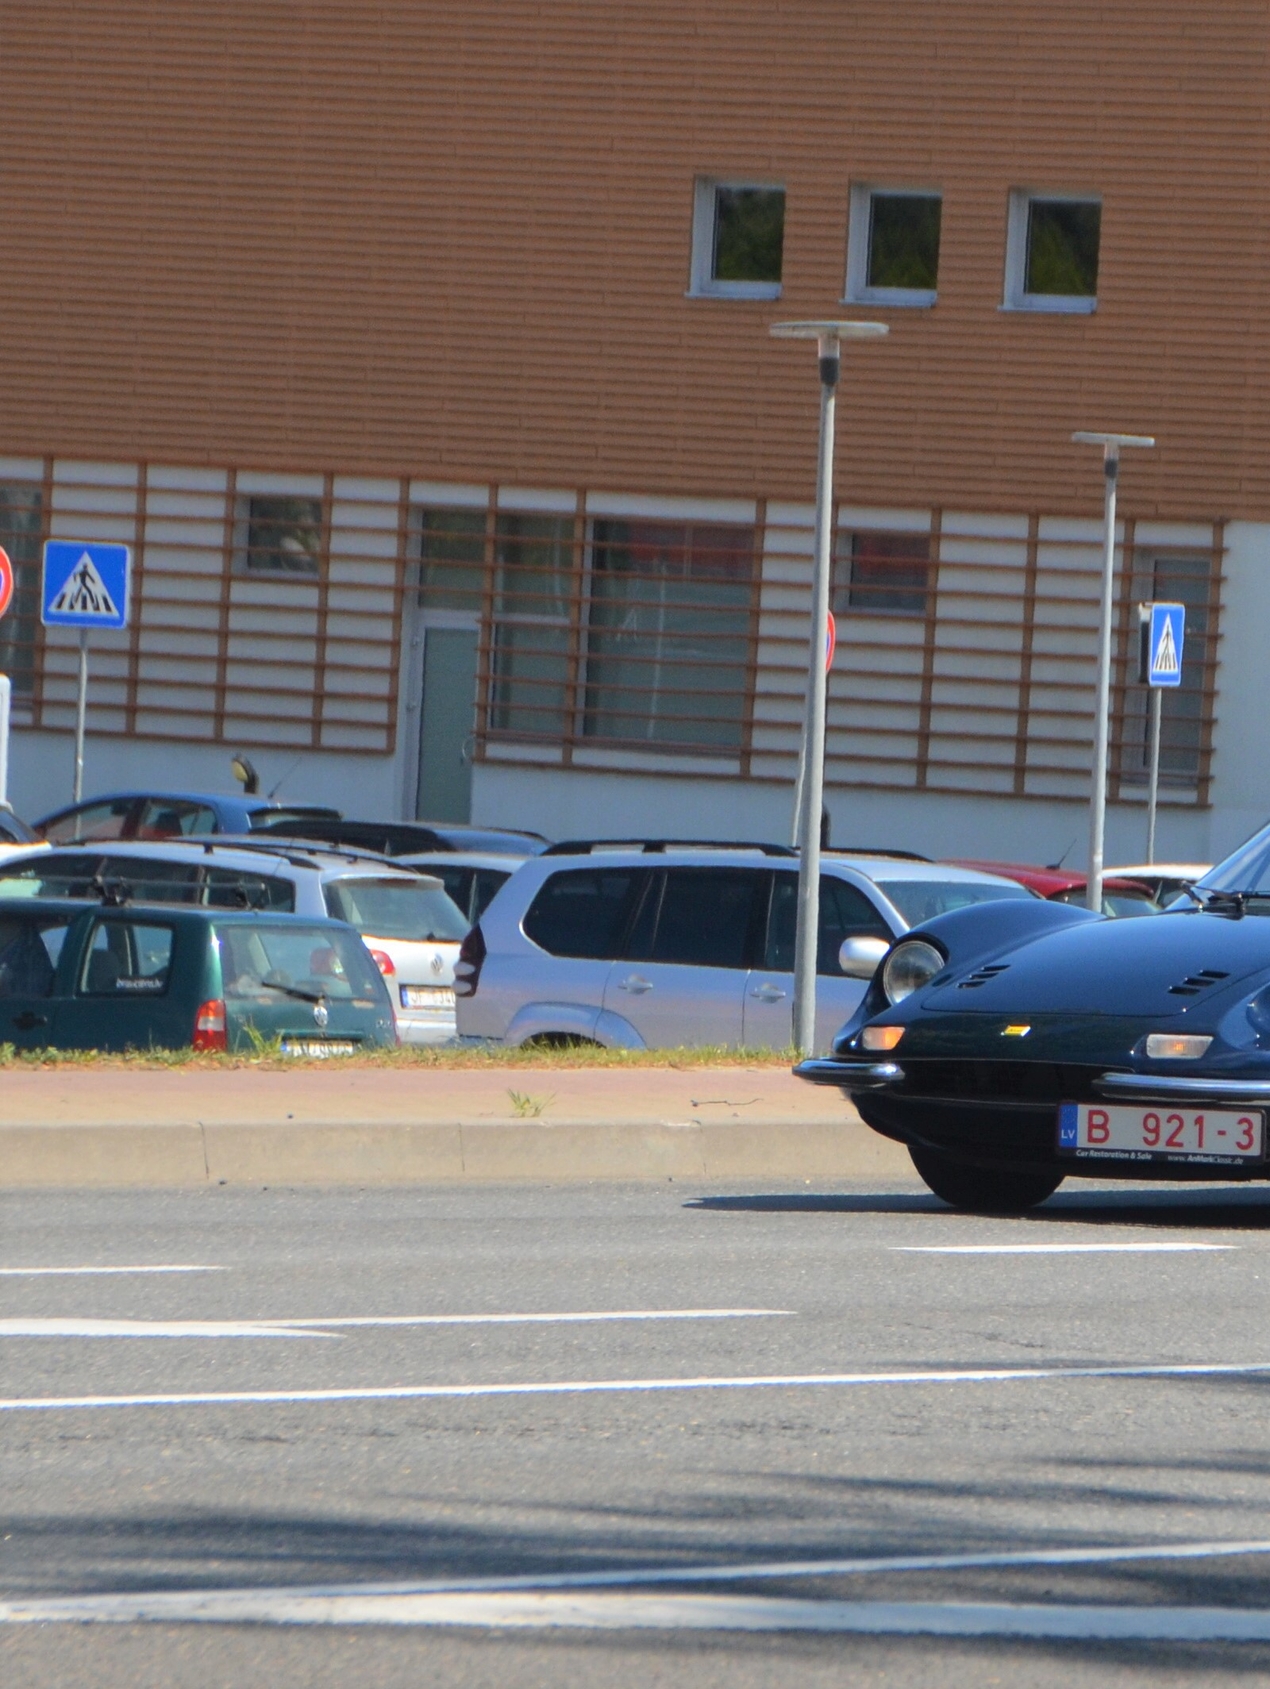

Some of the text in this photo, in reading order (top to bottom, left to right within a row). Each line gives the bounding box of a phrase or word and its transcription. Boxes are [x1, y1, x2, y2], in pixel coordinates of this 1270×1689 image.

[1060, 1129, 1076, 1139] LV
[1087, 1109, 1254, 1150] B 921-3
[1076, 1149, 1152, 1161] Car Restoration & Sale
